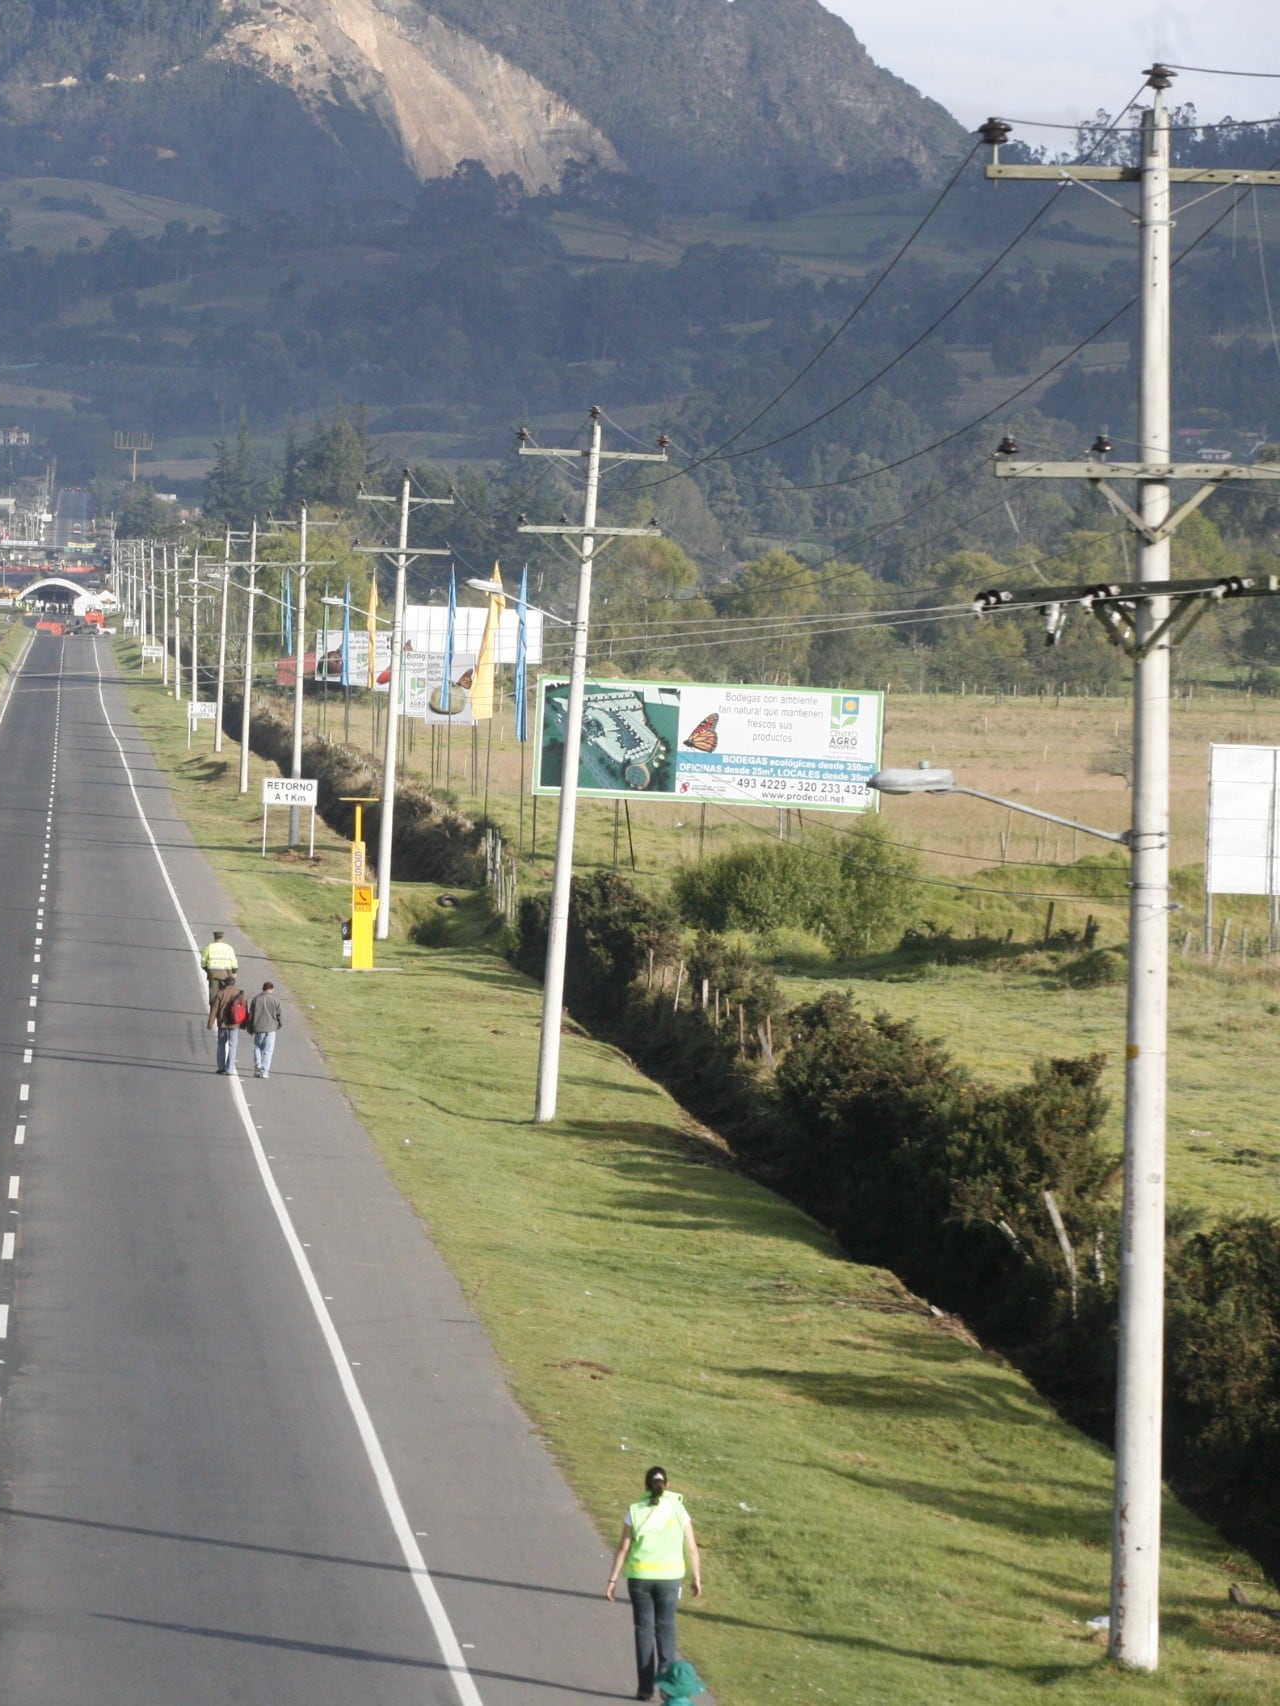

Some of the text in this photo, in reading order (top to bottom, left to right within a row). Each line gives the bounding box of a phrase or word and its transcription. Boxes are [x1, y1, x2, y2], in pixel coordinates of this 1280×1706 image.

[725, 692, 818, 705] Bodegas con ambiente
[719, 704, 824, 719] tan natural que mantienen
[747, 718, 793, 730] frescos sus
[752, 732, 792, 743] productos
[829, 736, 858, 746] AGRO
[722, 754, 768, 765] BODEGAS
[770, 758, 816, 769] ecológicas
[818, 760, 845, 770] desde
[679, 763, 722, 773] OFICINAS
[724, 766, 751, 776] desde
[777, 768, 821, 780] LOCALES
[823, 770, 849, 781] desde
[267, 781, 314, 792] RETORNO
[737, 777, 756, 789] 493
[759, 779, 787, 790] 4229
[797, 781, 817, 792] 320
[821, 783, 841, 794] 233
[843, 784, 872, 796] 4325
[274, 793, 281, 801] A
[761, 791, 845, 804] www.prodecol.net
[354, 852, 363, 876] SOS
